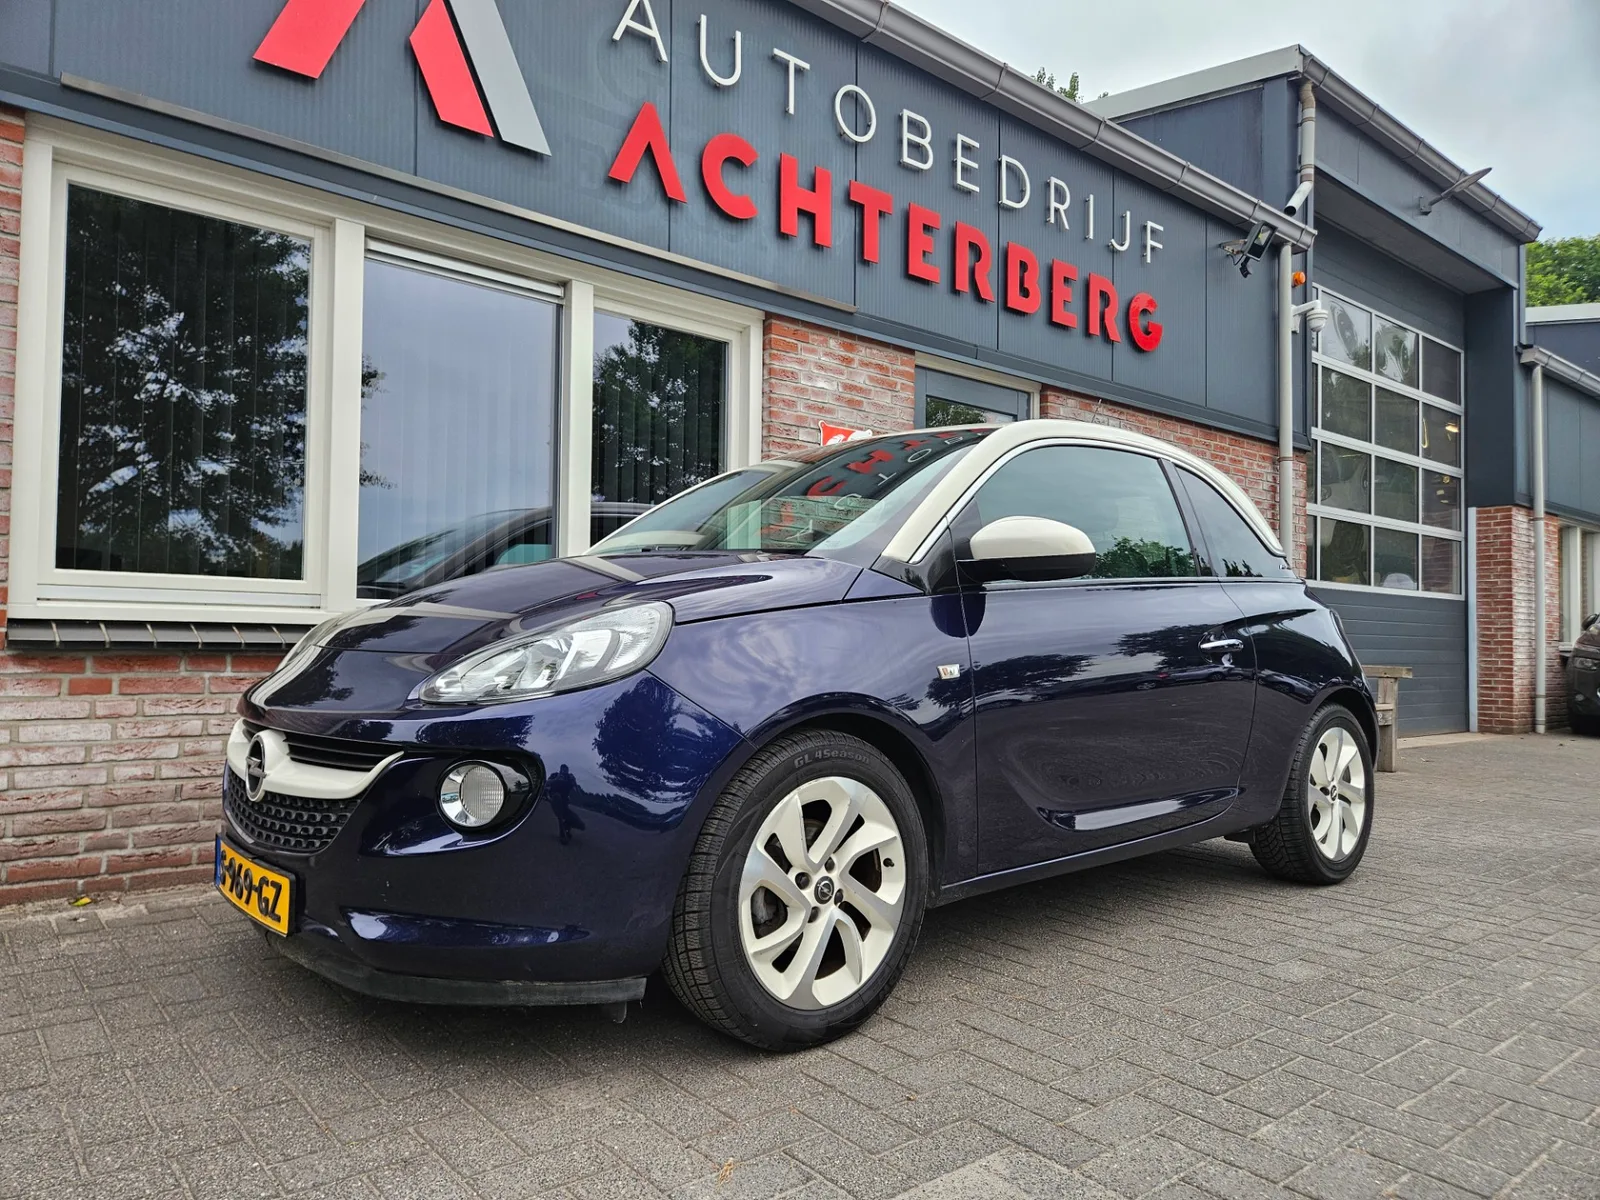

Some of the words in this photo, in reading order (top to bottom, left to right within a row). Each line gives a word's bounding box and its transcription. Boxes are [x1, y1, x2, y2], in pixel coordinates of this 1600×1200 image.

[608, 102, 1163, 352] ACHTERBERG
[612, 0, 1164, 263] AUTOBEDRIJF
[815, 748, 870, 764] 4Season
